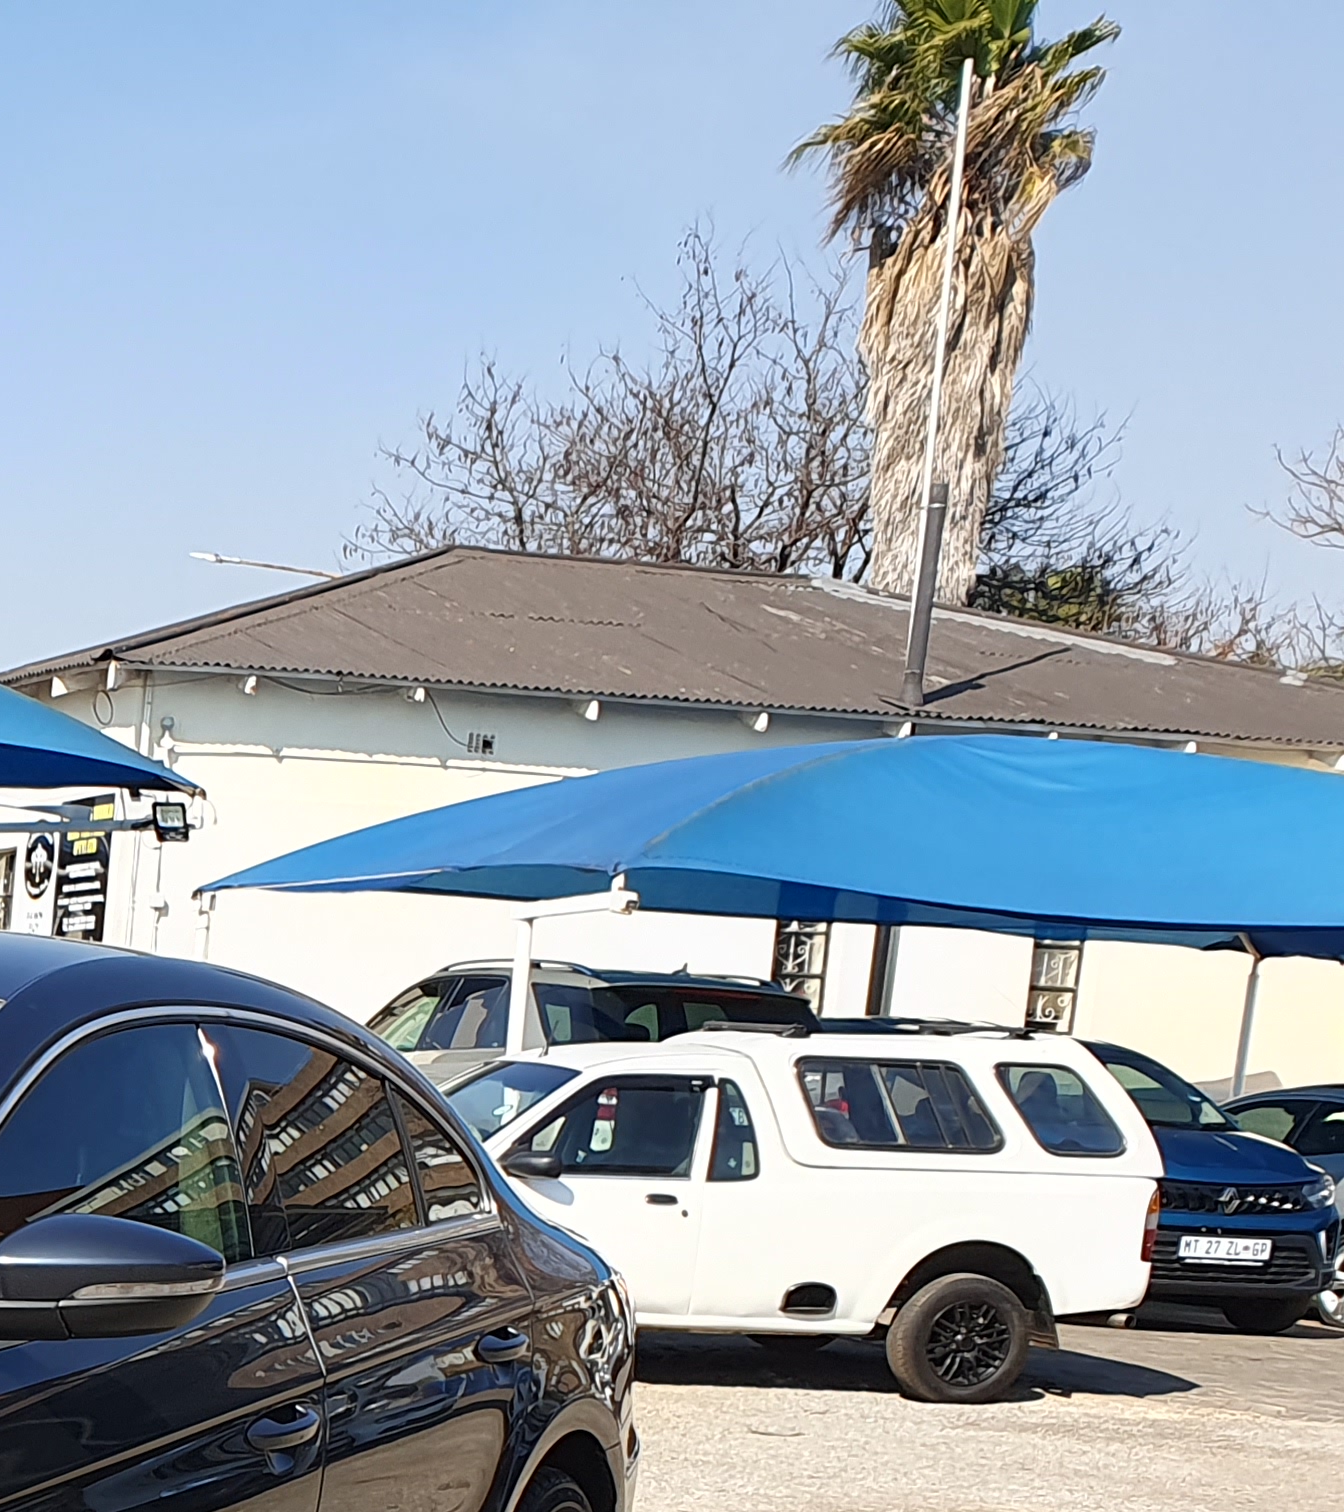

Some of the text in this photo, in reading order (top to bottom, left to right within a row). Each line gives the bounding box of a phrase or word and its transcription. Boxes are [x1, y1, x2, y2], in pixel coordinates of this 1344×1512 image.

[1205, 1240, 1222, 1255] 27
[1225, 1241, 1242, 1256] ZL
[1252, 1242, 1268, 1257] GP
